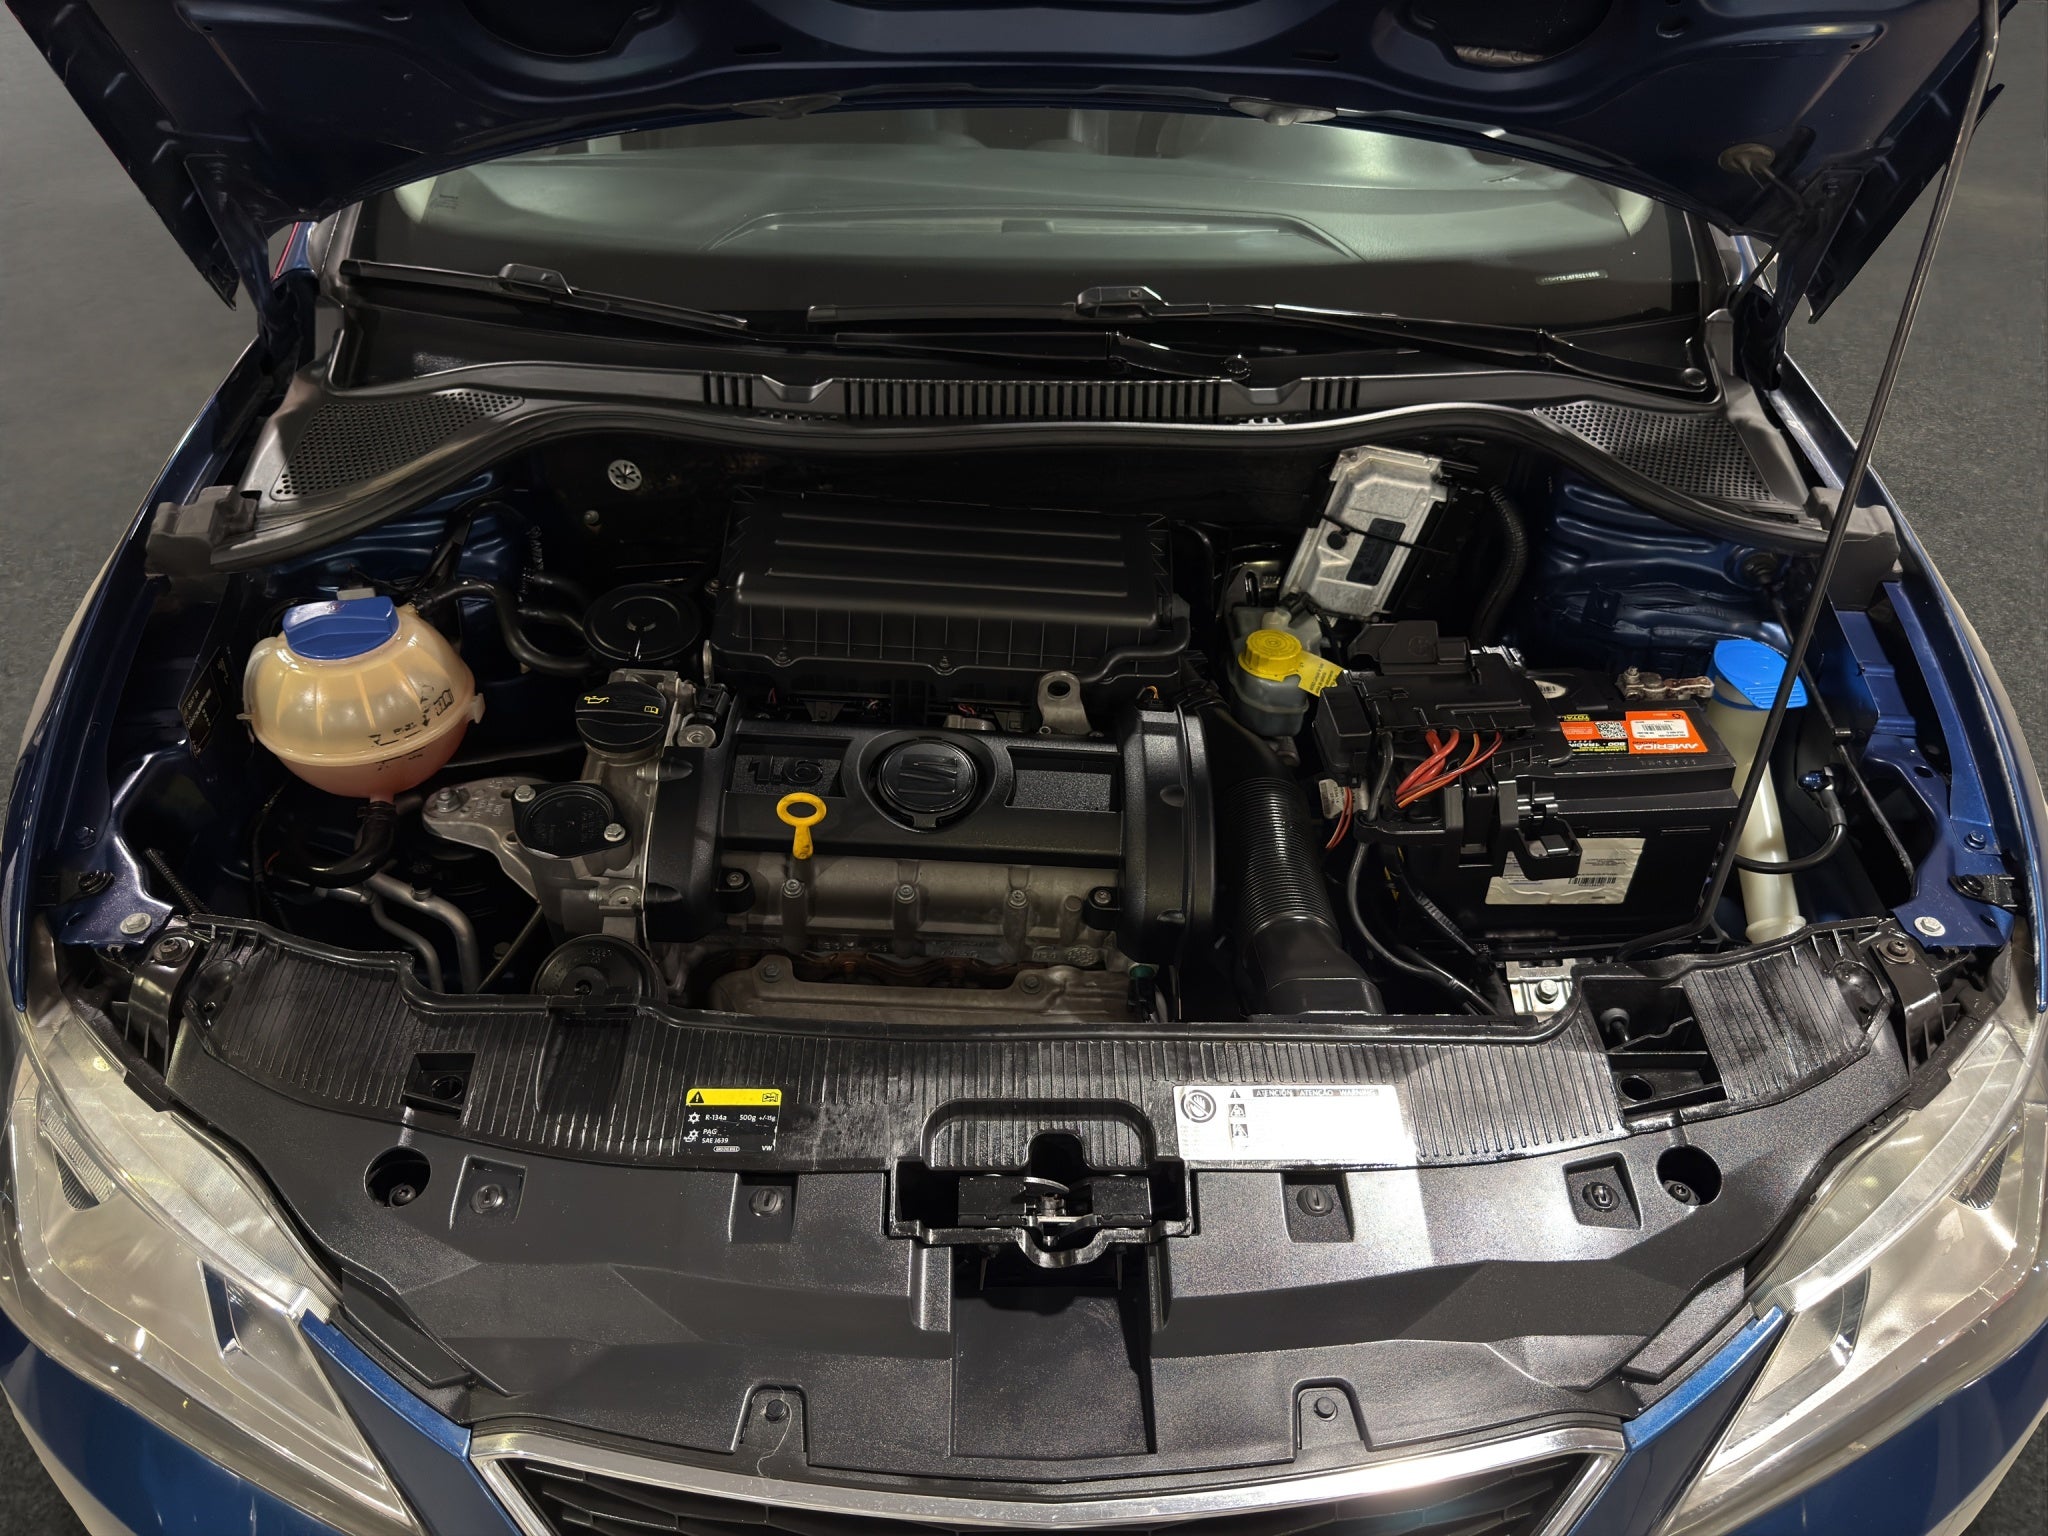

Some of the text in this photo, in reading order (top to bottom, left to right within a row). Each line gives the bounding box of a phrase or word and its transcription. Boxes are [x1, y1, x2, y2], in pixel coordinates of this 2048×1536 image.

[1633, 743, 1698, 751] AMÉRICA
[748, 755, 823, 784] 1.6
[739, 1114, 757, 1122] 500g
